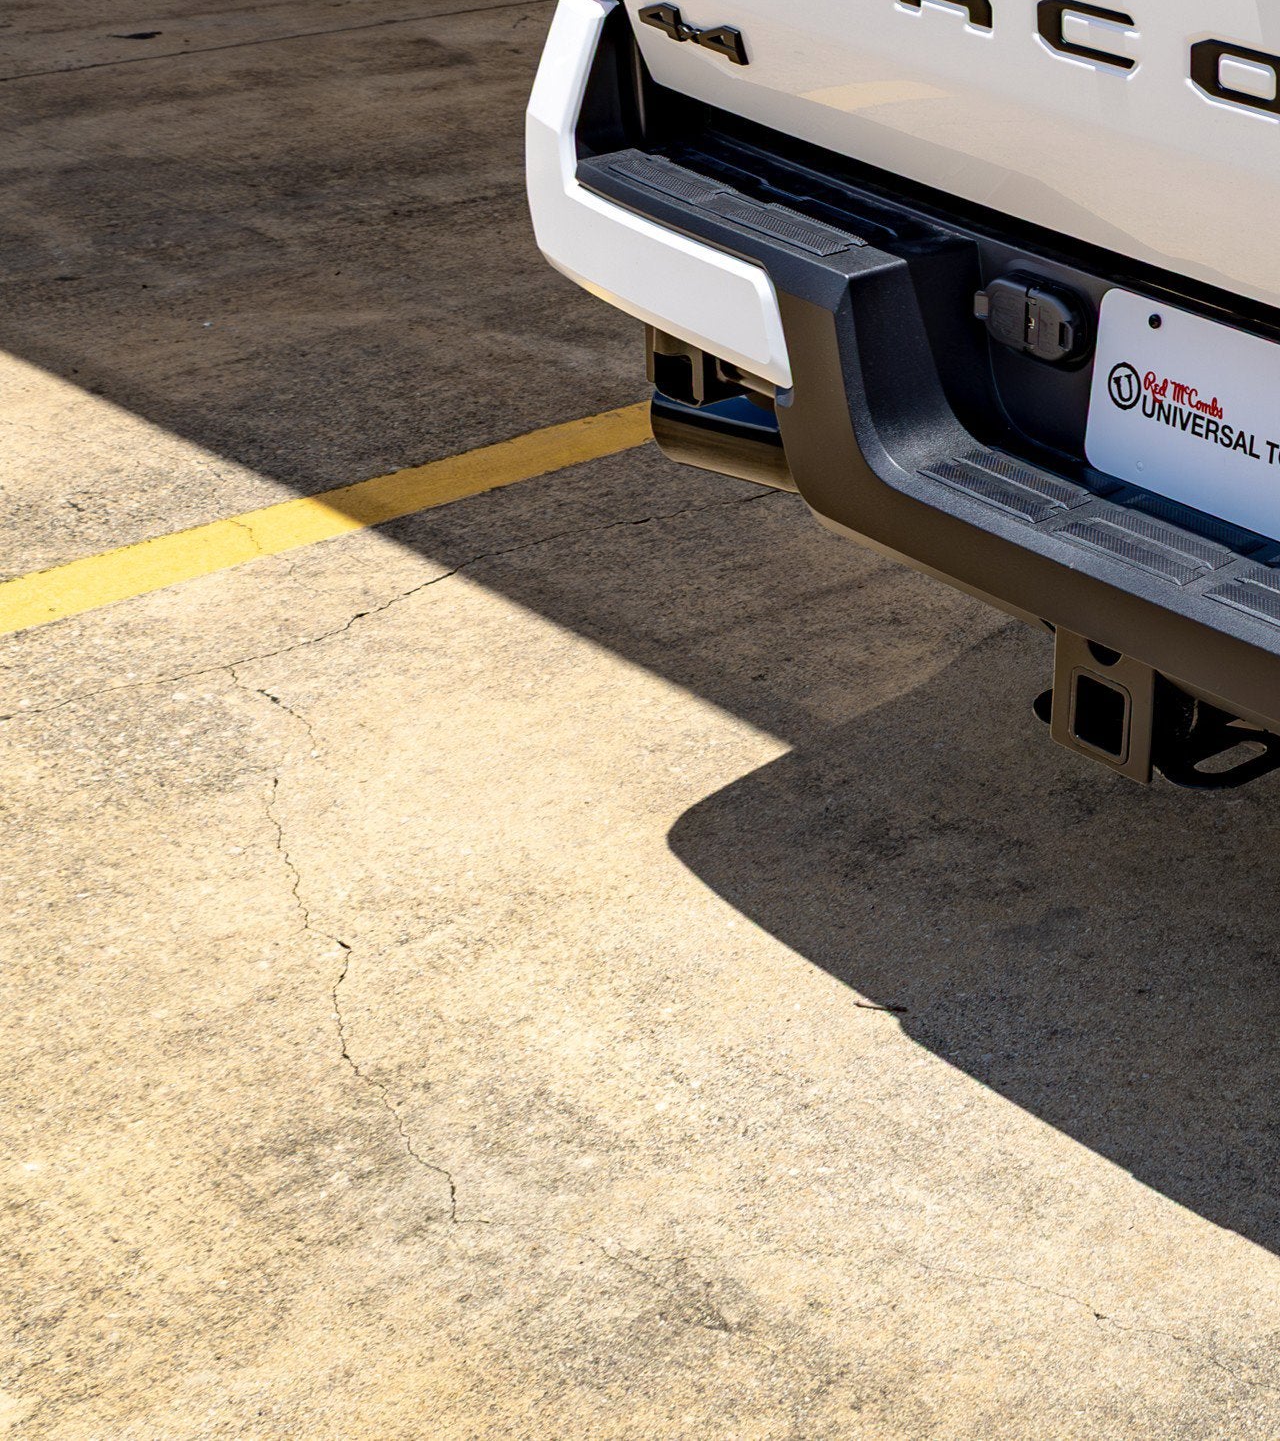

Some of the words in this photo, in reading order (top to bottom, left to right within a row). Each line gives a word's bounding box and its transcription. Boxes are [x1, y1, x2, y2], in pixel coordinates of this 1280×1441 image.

[1143, 371, 1168, 404] Red
[1170, 379, 1223, 419] McCombs
[1141, 394, 1261, 460] UNIVERSAL
